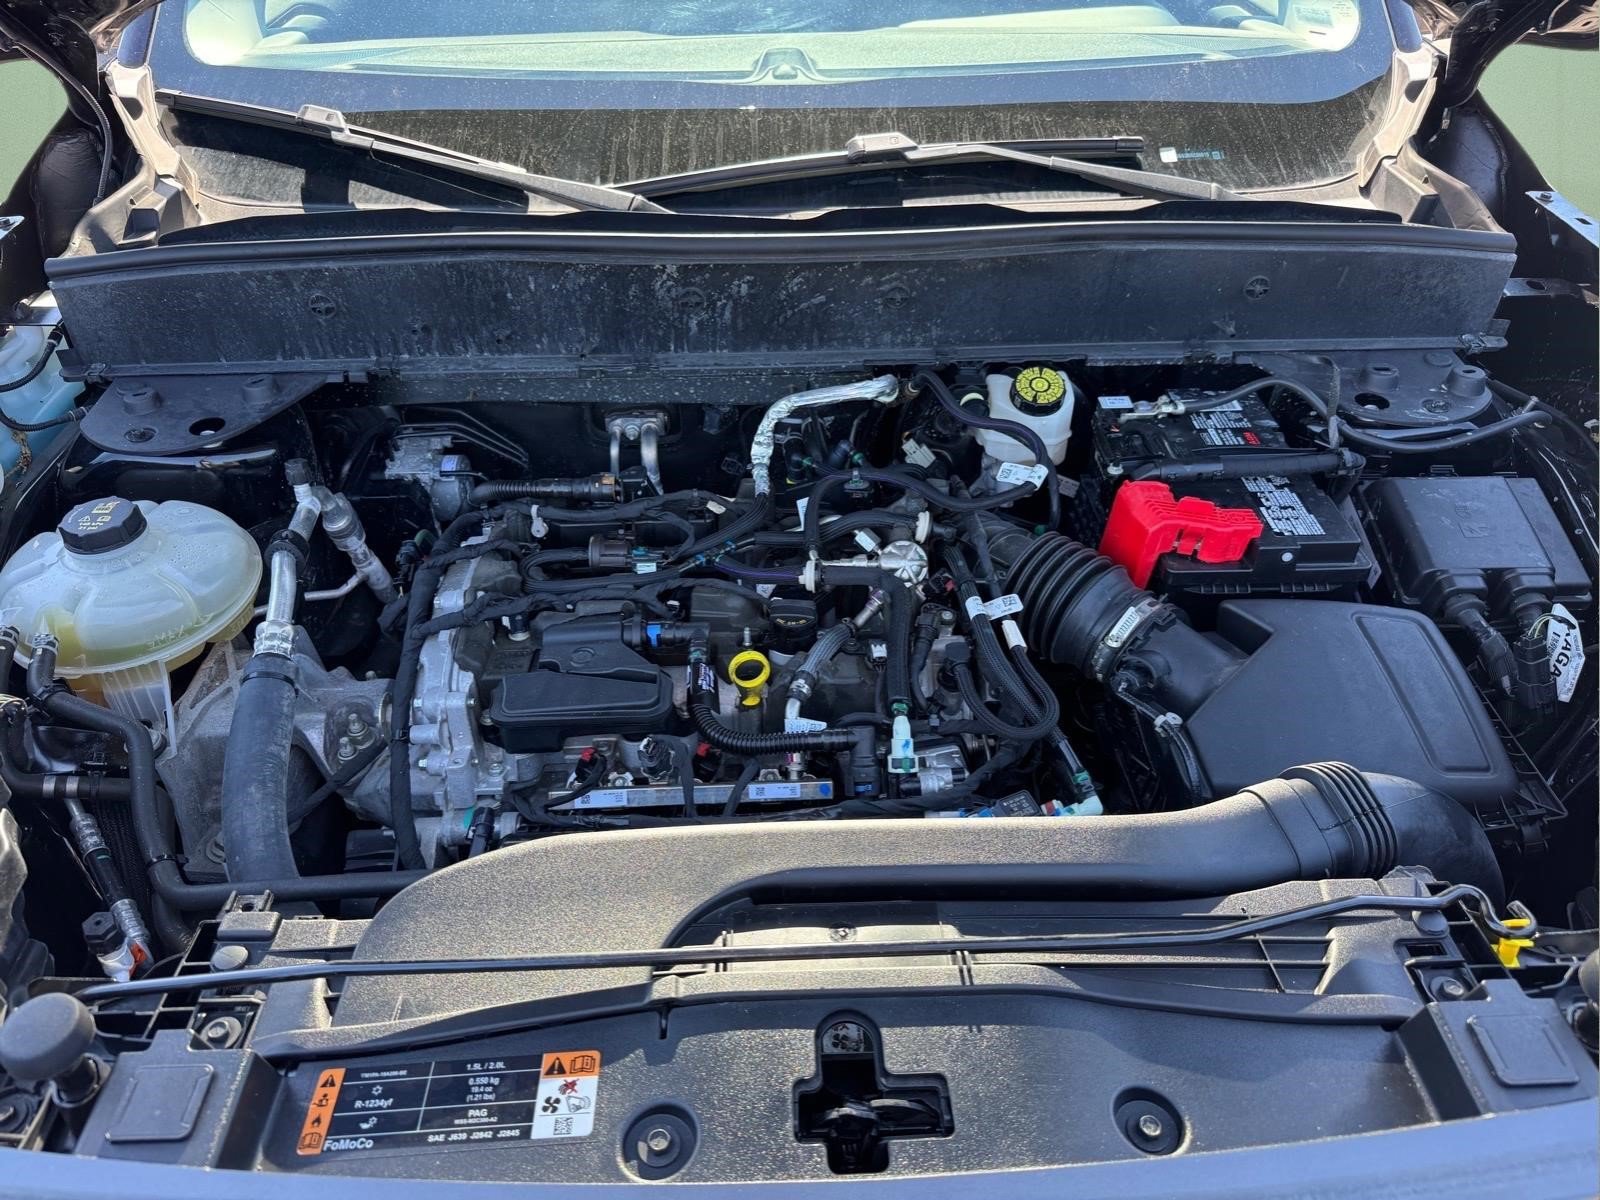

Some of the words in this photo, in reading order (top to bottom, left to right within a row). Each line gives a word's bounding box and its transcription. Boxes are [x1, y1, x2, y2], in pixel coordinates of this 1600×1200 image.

[468, 1077, 488, 1085] 0.550
[490, 1076, 500, 1085] kg
[354, 1098, 394, 1109] R-1234yf
[468, 1109, 488, 1117] PAG
[427, 1134, 445, 1143] SAE
[448, 1133, 467, 1141] J639
[324, 1137, 374, 1151] FoMoCo
